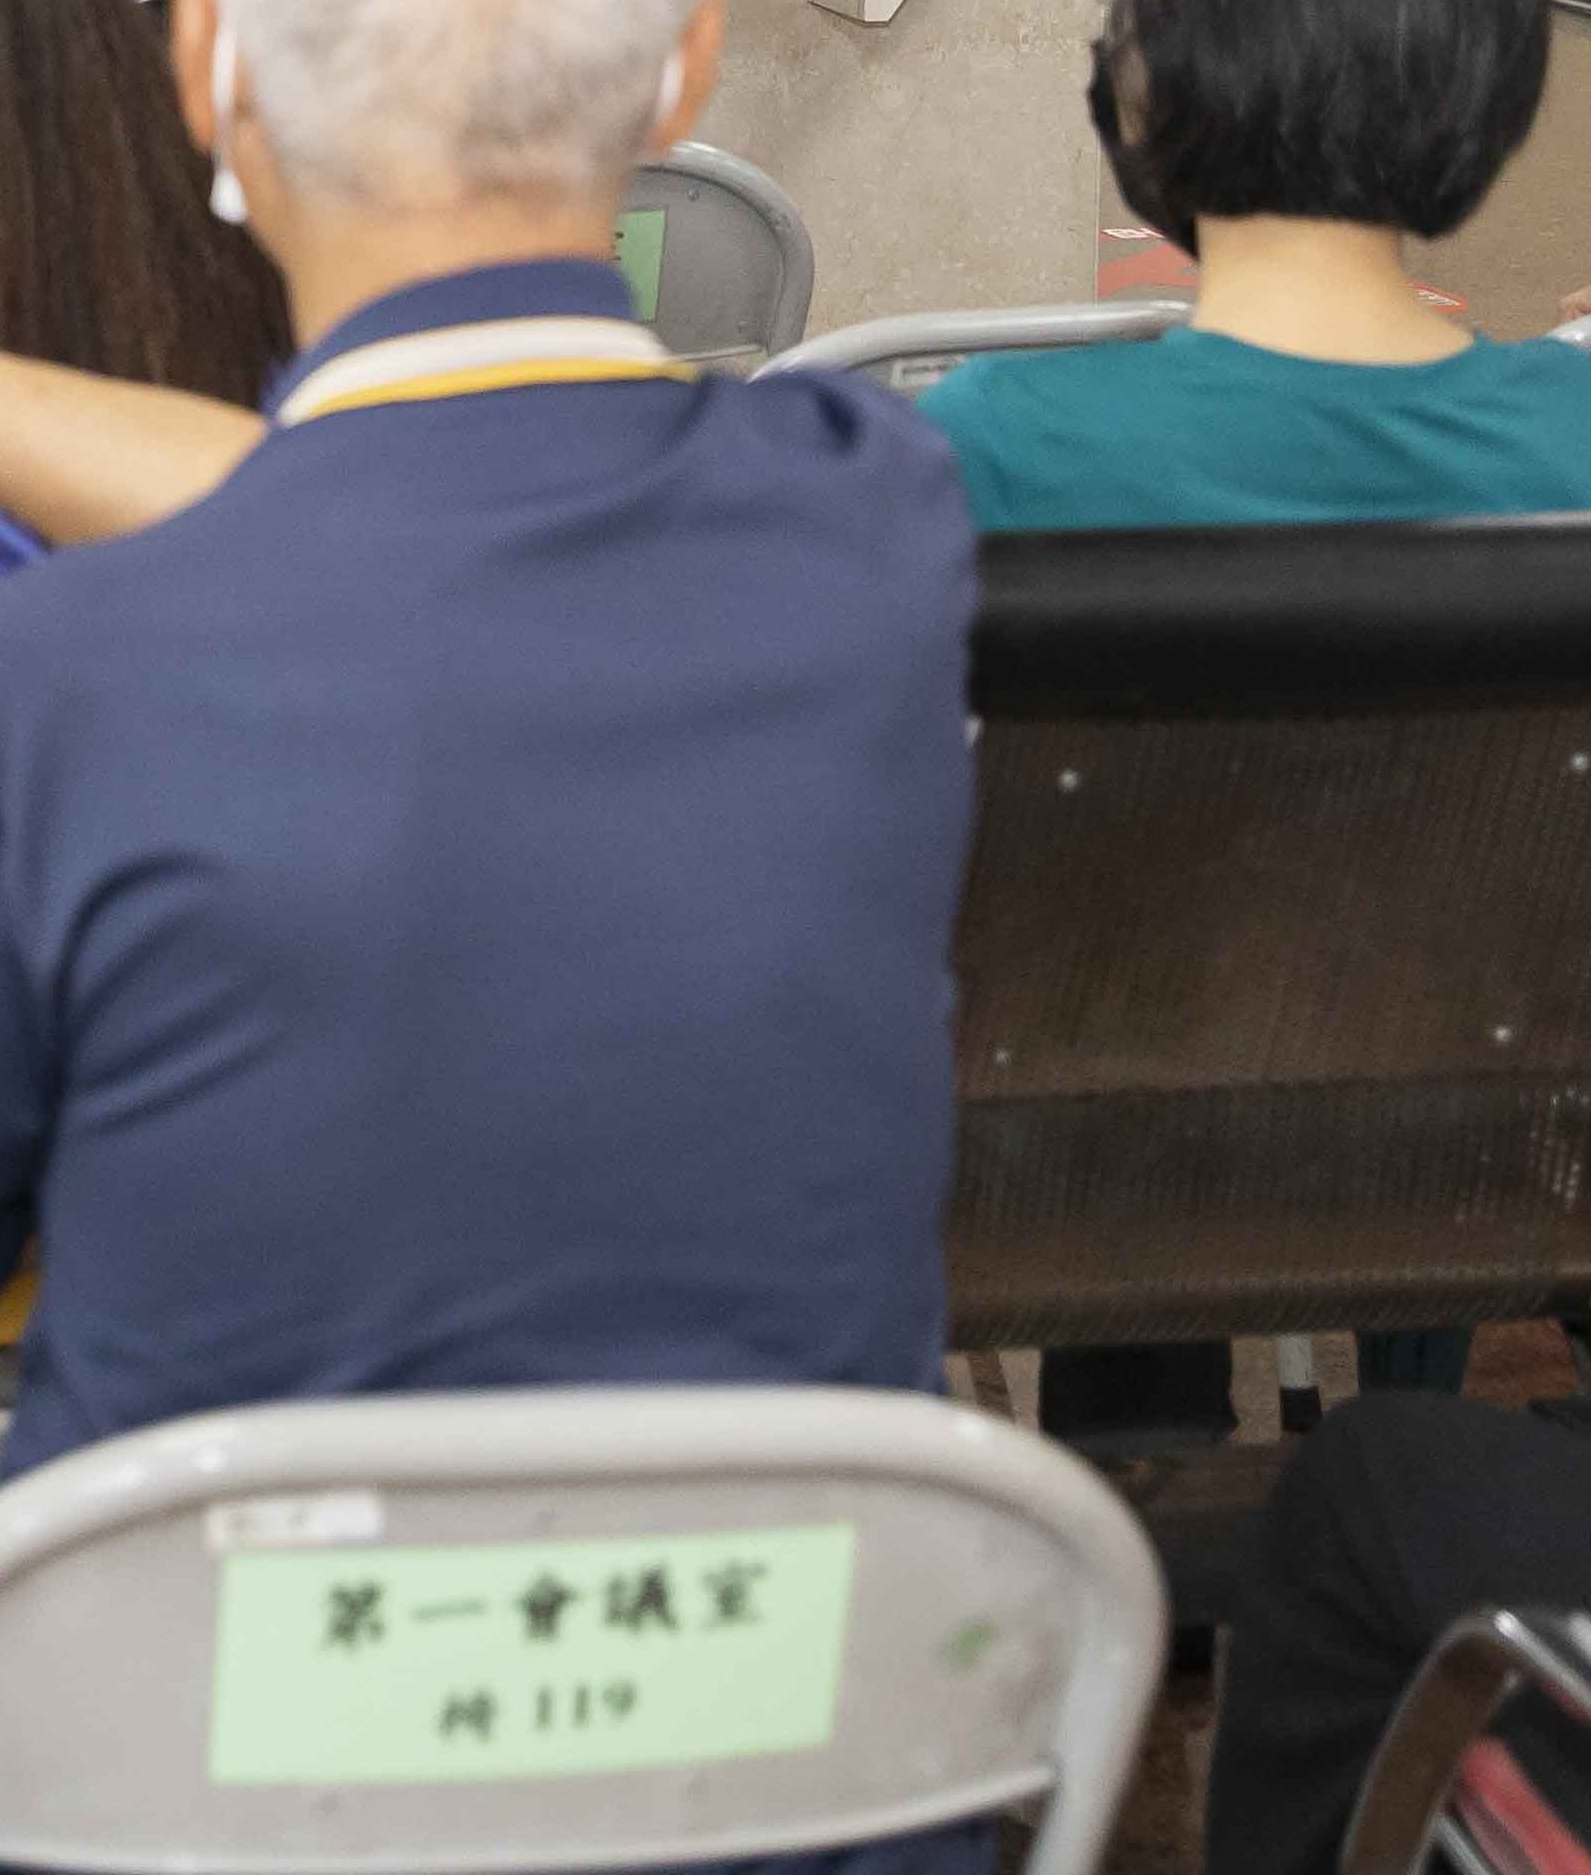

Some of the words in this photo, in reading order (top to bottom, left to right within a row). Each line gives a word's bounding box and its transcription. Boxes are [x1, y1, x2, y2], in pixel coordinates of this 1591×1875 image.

[319, 1562, 770, 1652] 第一會議室
[531, 1682, 639, 1732] 119
